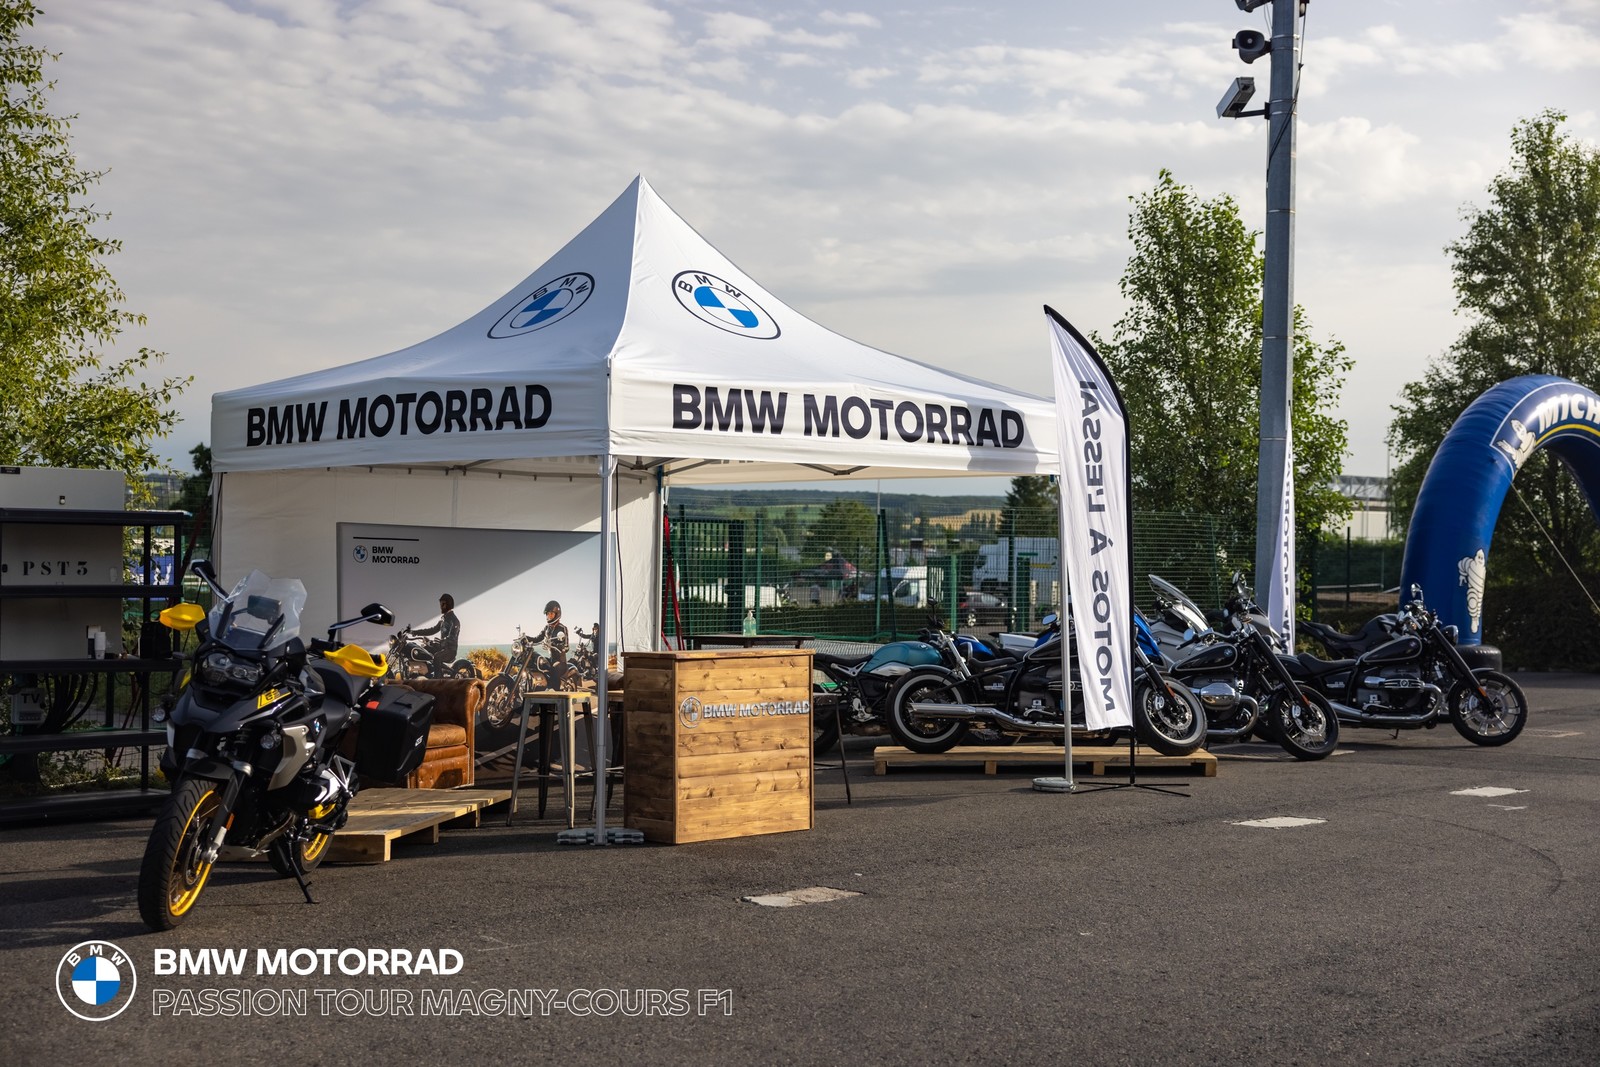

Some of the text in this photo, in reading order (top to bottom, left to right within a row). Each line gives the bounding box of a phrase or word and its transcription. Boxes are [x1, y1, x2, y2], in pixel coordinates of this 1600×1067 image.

[532, 275, 588, 300] BMW
[678, 274, 742, 298] BMW
[246, 384, 552, 447] BMW MOTORRAD
[672, 383, 1025, 448] BMW MOTORRAD
[372, 546, 394, 554] BMW
[372, 555, 420, 564] MOTORRAD
[20, 693, 40, 704] TV
[703, 700, 810, 718] BMW MOTORRAD
